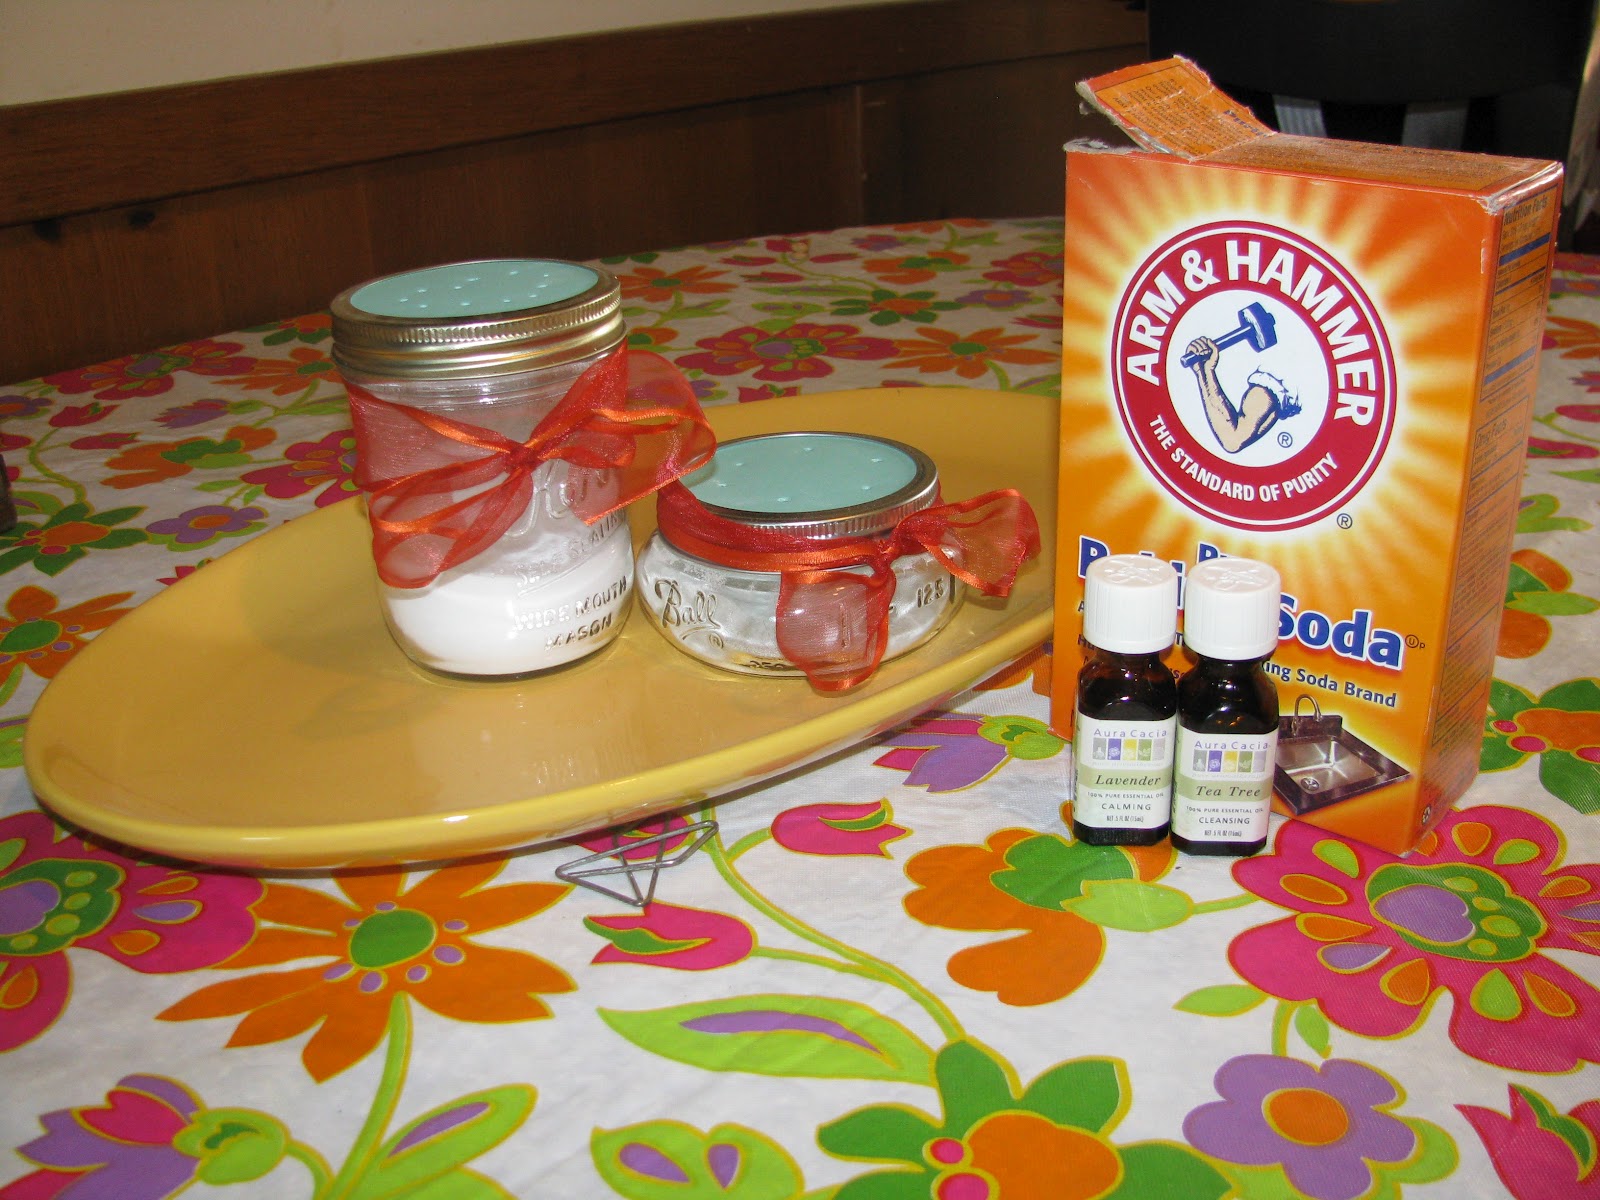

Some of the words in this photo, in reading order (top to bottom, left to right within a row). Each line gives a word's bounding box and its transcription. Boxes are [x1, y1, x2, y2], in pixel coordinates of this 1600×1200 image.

[1126, 270, 1186, 387] ARM
[1180, 249, 1221, 292] &
[1225, 239, 1376, 427] HAMMER
[1149, 414, 1176, 451] THE
[1170, 447, 1255, 502] STANDARD
[1259, 483, 1281, 502] OF
[1285, 452, 1339, 499] PURITY
[575, 575, 628, 617] MOUTH
[654, 578, 721, 629] Ball
[916, 577, 944, 609] 125
[544, 612, 613, 651] MASON
[1277, 592, 1403, 671] Soda
[1295, 668, 1338, 692] Soda
[1343, 681, 1398, 708] Brand
[1093, 728, 1126, 738] Aura
[1130, 729, 1168, 738] Cacia
[1194, 740, 1227, 750] Aura
[1231, 741, 1269, 750] Cacia
[1095, 774, 1162, 786] Lavender
[1196, 785, 1222, 796] Tea
[1229, 786, 1261, 797] Tree
[1101, 803, 1152, 811] CALMING
[1198, 817, 1250, 825] CLEANSING
